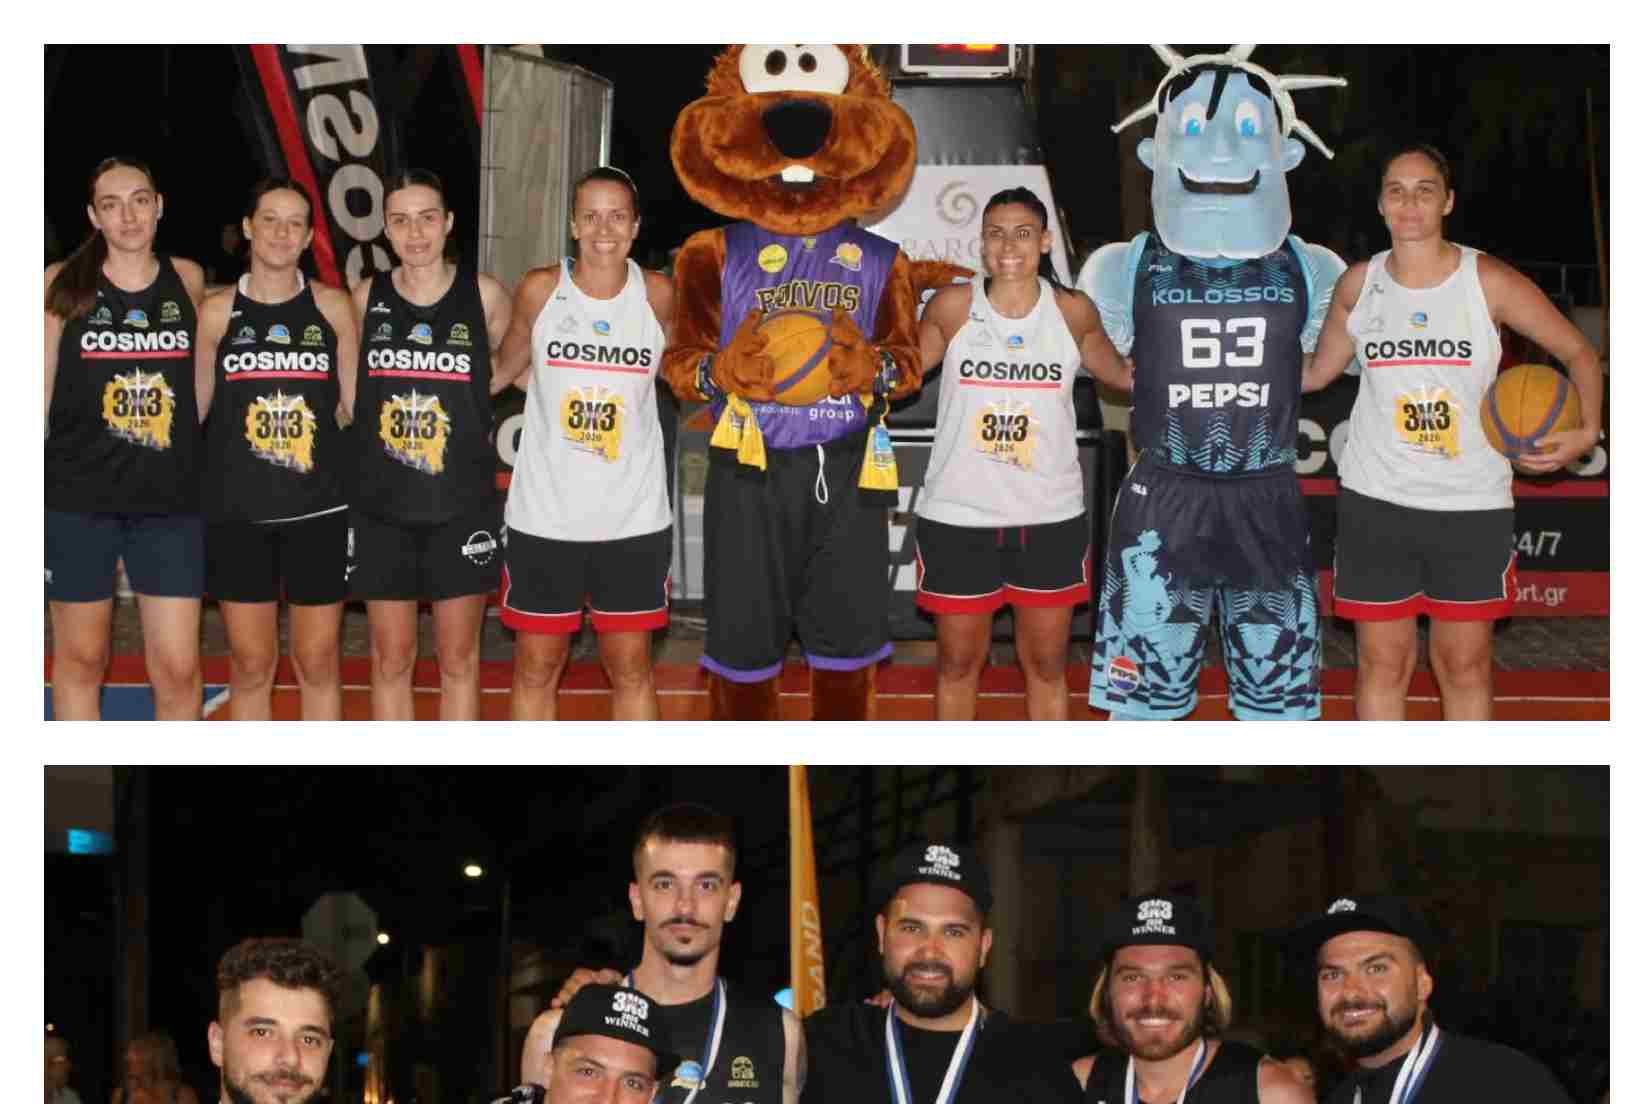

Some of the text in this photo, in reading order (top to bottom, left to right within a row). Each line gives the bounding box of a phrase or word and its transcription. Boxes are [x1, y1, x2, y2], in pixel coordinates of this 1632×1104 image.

[1152, 285, 1295, 305] KOLOSSOS
[81, 330, 190, 352] COSMOS
[1180, 317, 1266, 369] 63
[1365, 340, 1472, 361] COSMOS
[223, 352, 329, 373] COSMOS
[368, 349, 471, 373] COSMOS
[547, 341, 652, 367] COSMOS
[960, 360, 1062, 382] COSMOS
[113, 387, 162, 417] 3X3
[1168, 382, 1271, 408] PEPSI
[256, 409, 304, 440] 3X3
[390, 409, 437, 440] 3X3
[568, 400, 617, 431] 3X3
[808, 404, 856, 422] group
[1403, 401, 1449, 433] 3X3
[982, 414, 1029, 442] 3X3
[1512, 531, 1562, 558] 4/7
[918, 867, 961, 880] WINNER
[1132, 925, 1176, 936] WINNER
[604, 1015, 650, 1037] WINNER
